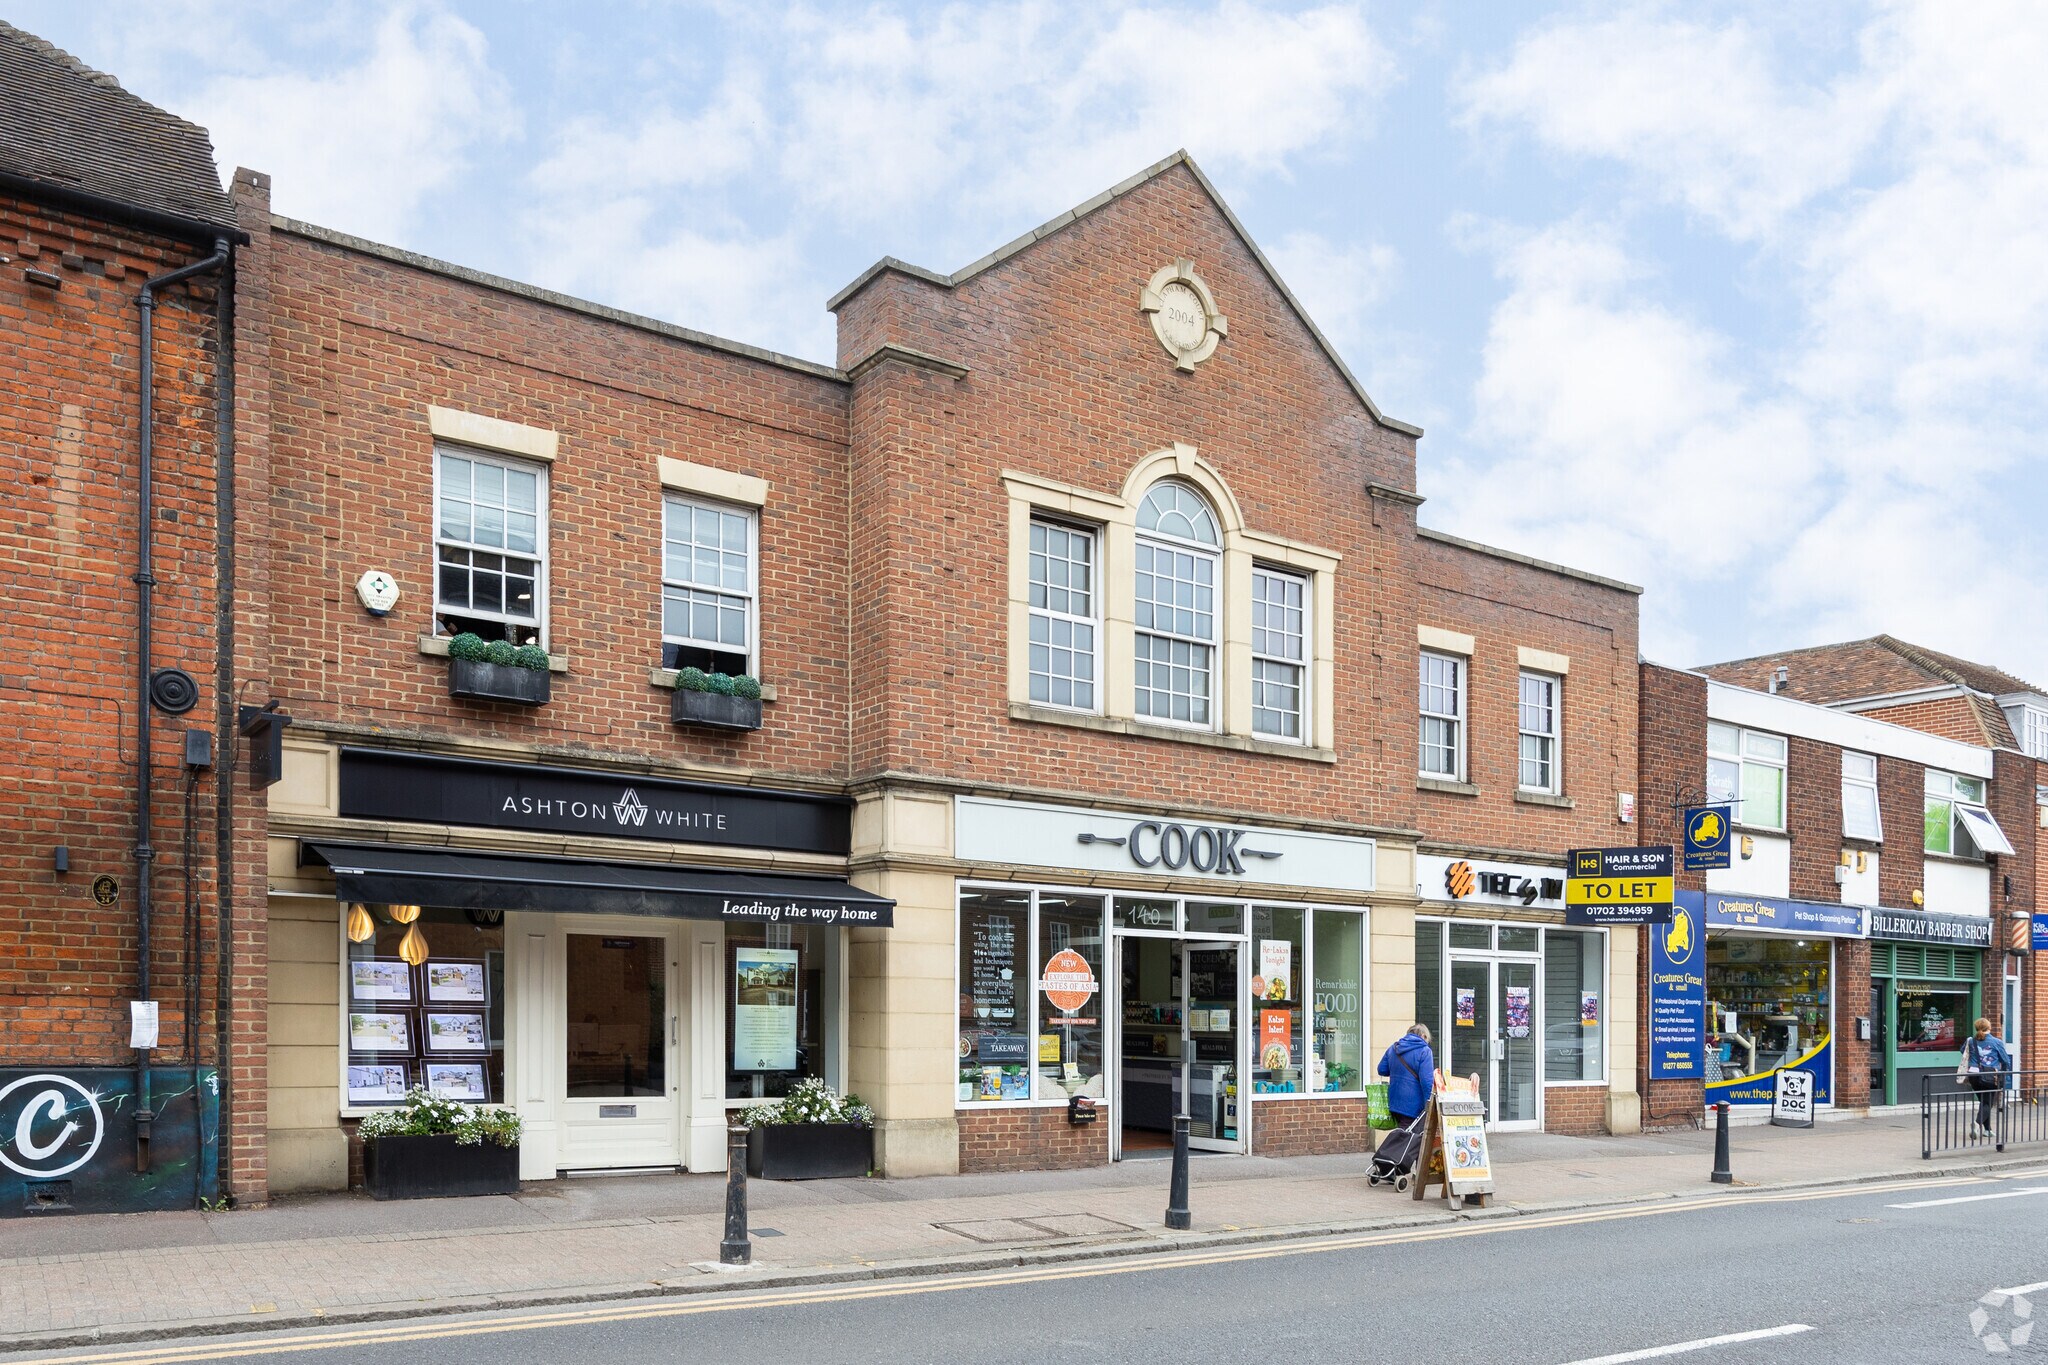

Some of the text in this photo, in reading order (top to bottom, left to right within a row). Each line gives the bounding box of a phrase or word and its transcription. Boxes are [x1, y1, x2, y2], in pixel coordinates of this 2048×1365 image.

[1160, 285, 1203, 320] CLAPHAM COURT
[1169, 308, 1194, 327] 2004
[502, 796, 605, 820] ASHTON
[656, 810, 726, 829] WHITE
[1130, 820, 1246, 874] COOK
[1605, 854, 1664, 863] HAIR & SON
[1583, 883, 1657, 898] TO LET
[722, 900, 877, 923] Leading the way home
[1586, 906, 1653, 915] 01702 394959
[1718, 900, 1775, 918] Creatures Great
[1128, 904, 1160, 925] 140
[1736, 913, 1758, 924] & small
[1803, 912, 1814, 922] Shop
[1819, 914, 1840, 925] Grooming
[1841, 915, 1856, 924] Parlour
[1873, 916, 1987, 940] BILLERICAY BARBER SHOP
[988, 933, 1003, 941] cook
[974, 942, 988, 950] using
[1263, 945, 1288, 954] Re-Laksa
[988, 950, 1014, 958] ingredients
[985, 958, 1013, 967] techniques
[1061, 959, 1077, 967] NEW
[1265, 956, 1286, 965] tonight
[1315, 978, 1357, 989] Remarkable
[1654, 973, 1702, 986] Creatures Great
[981, 980, 1014, 990] everything
[1080, 983, 1096, 991] ASIA
[1669, 983, 1674, 991] &
[1907, 984, 1931, 999] years
[1316, 993, 1357, 1013] FOOD
[1268, 1015, 1284, 1024] Katsu
[1335, 1019, 1357, 1029] your
[991, 1044, 1025, 1053] TAKEAWAY
[1666, 1051, 1690, 1059] Telephone:
[1256, 1080, 1296, 1093] Cook
[1453, 1105, 1474, 1113] COOK
[1782, 1100, 1806, 1109] DOG
